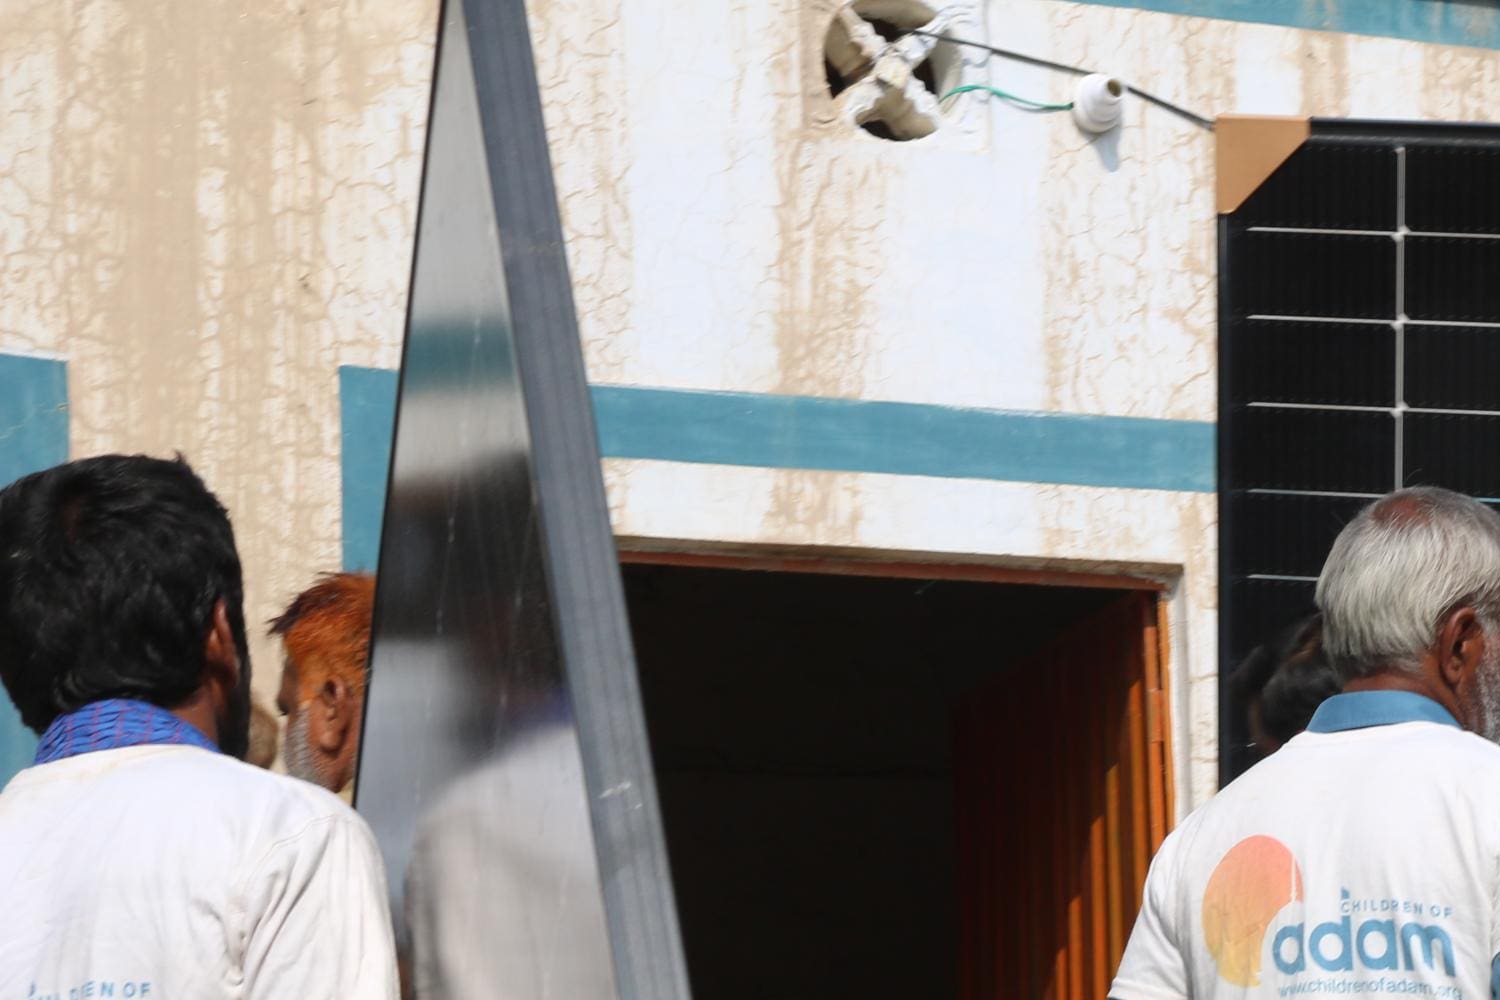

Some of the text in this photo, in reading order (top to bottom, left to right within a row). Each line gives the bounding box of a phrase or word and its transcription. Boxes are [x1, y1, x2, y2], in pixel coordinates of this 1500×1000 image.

[1339, 898, 1454, 918] CHILDREN OF
[1272, 886, 1457, 977] adam
[122, 981, 152, 998] OF
